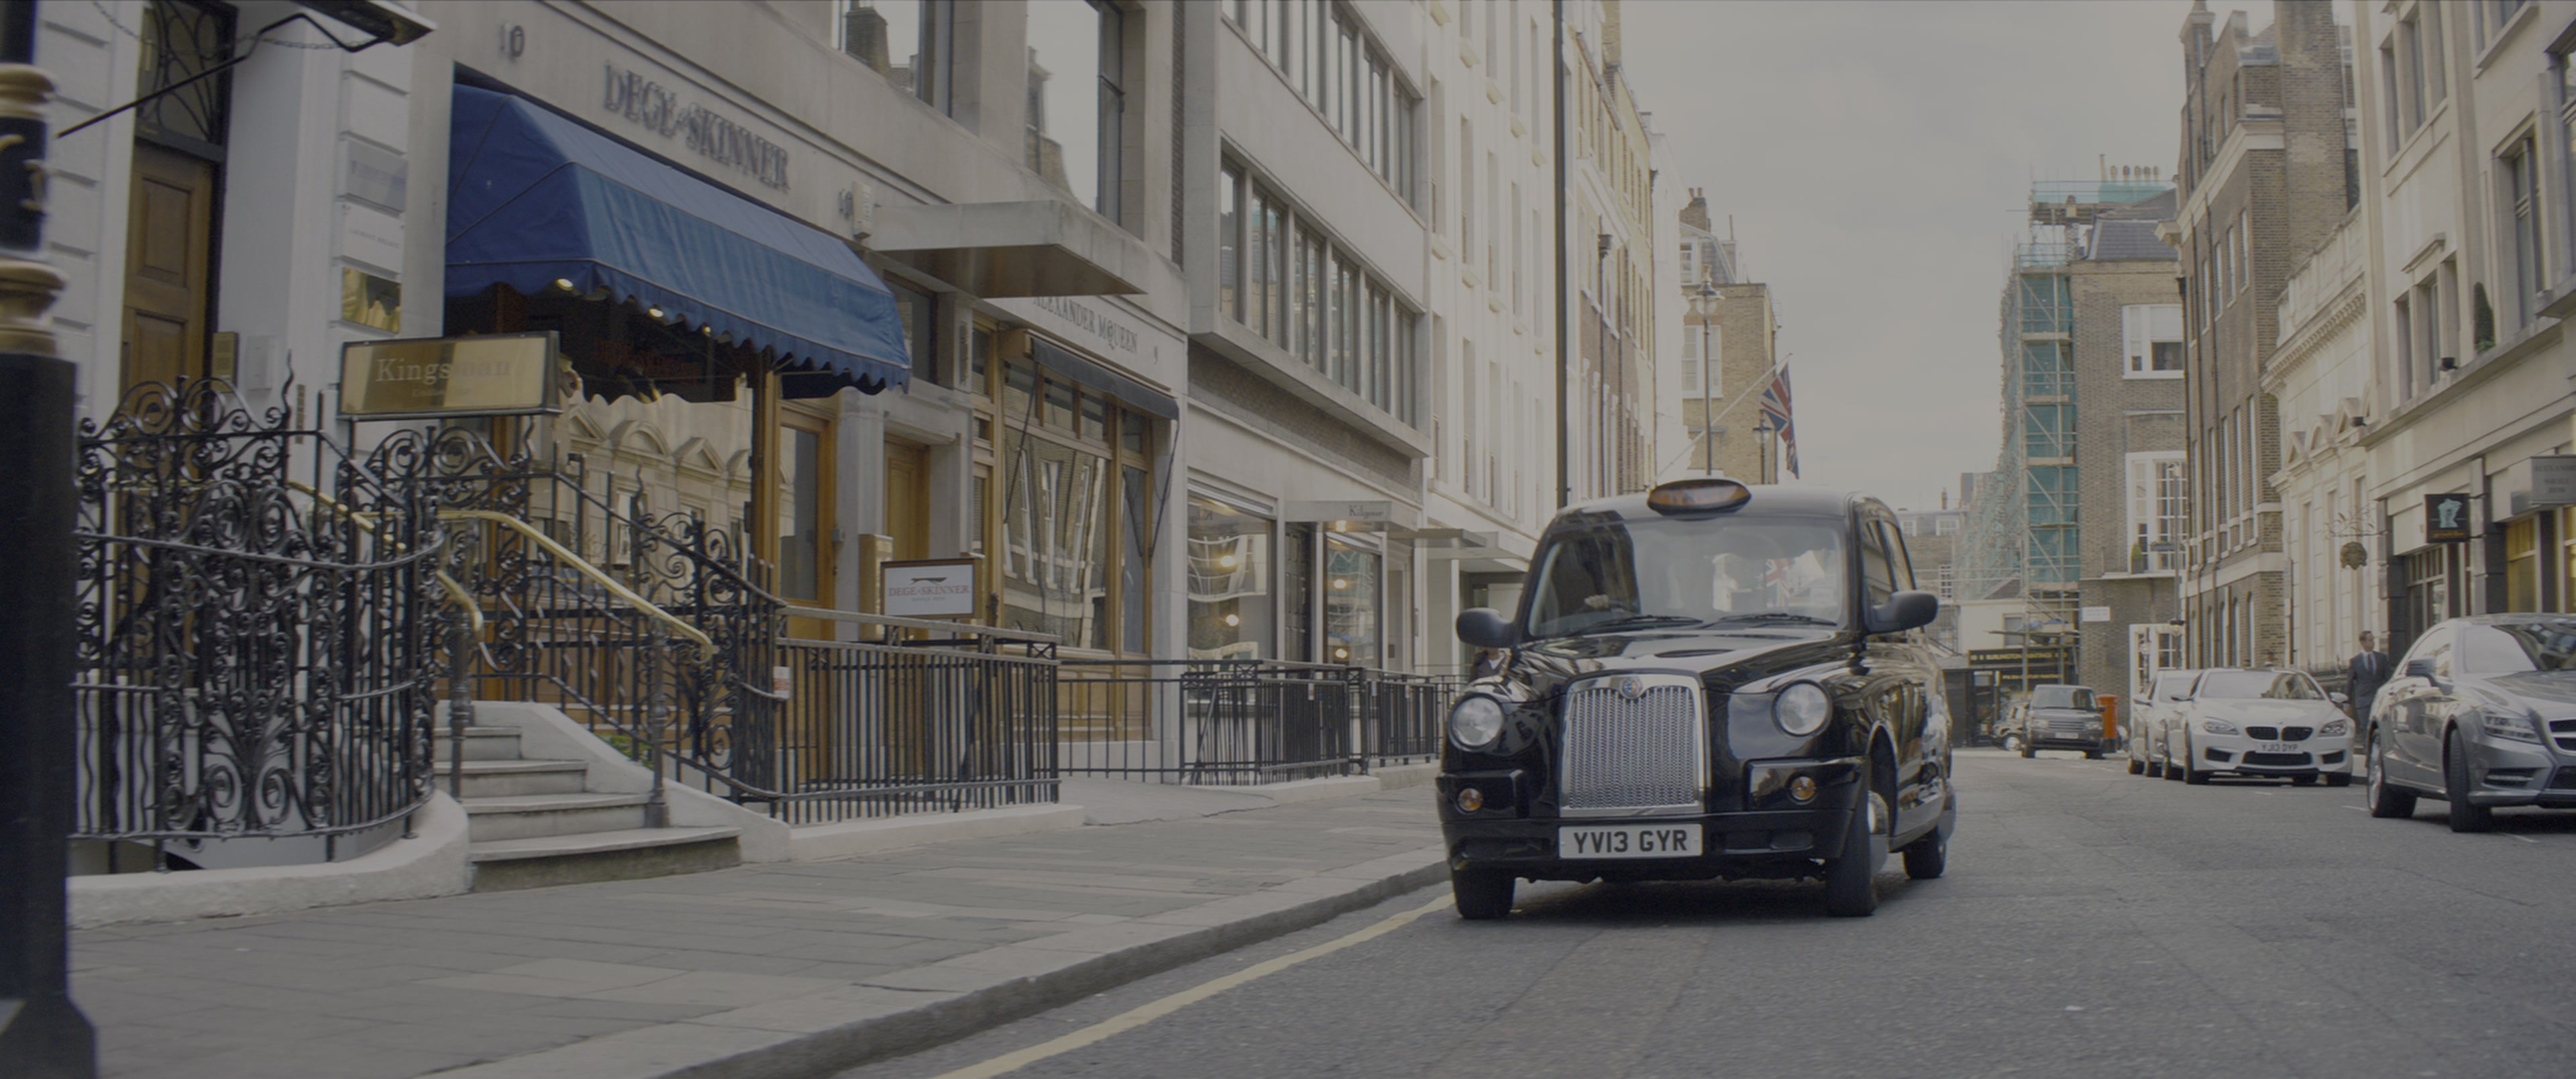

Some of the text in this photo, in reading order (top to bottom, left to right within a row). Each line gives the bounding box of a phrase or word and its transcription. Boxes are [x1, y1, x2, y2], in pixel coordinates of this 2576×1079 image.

[686, 103, 791, 191] SKINNER
[1349, 505, 1384, 519] Kilgour
[889, 587, 918, 597] DEGE
[921, 585, 970, 595] SKINNER
[1574, 829, 1687, 853] YV13 GYR
